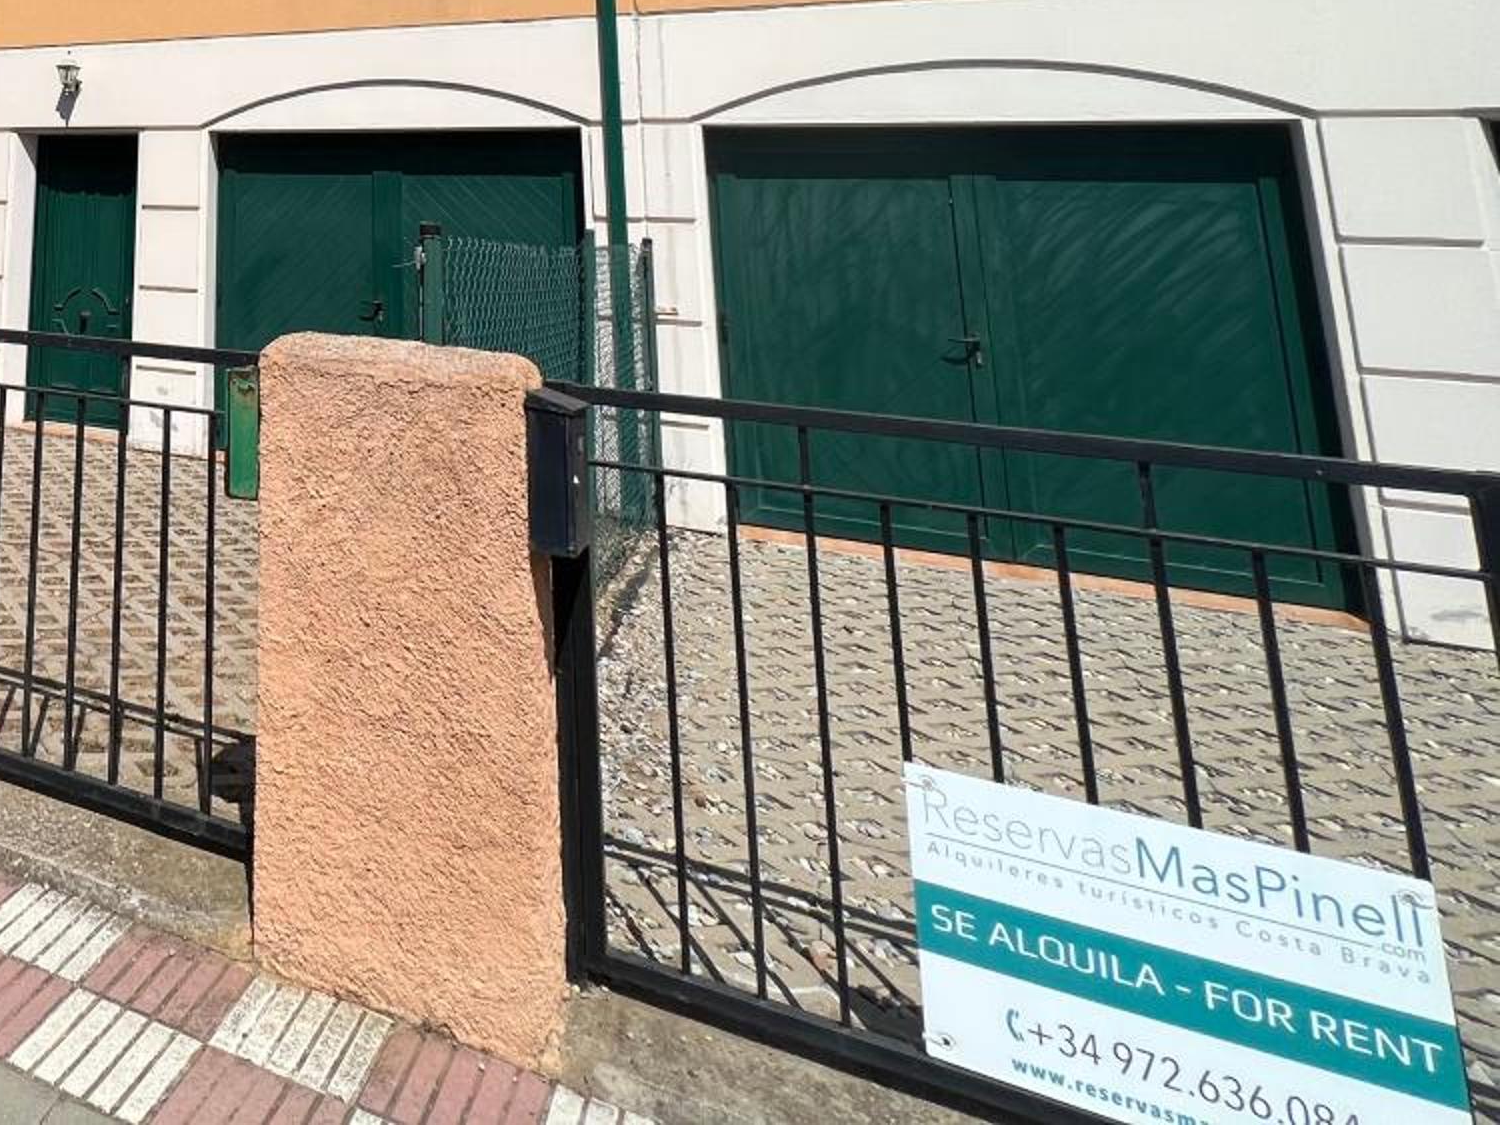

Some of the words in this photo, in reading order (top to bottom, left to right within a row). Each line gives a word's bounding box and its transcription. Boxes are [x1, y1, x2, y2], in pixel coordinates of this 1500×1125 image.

[926, 840, 1064, 890] Alquileres
[1236, 920, 1321, 957] Costa
[1341, 946, 1431, 984] Brava
[931, 904, 978, 941] SE
[988, 922, 1165, 996] ALQUILA
[1204, 980, 1297, 1034] FOR
[1309, 1010, 1443, 1073] RENT
[1011, 1058, 1211, 1125] www.reservasm
[1027, 1023, 1102, 1066] +34
